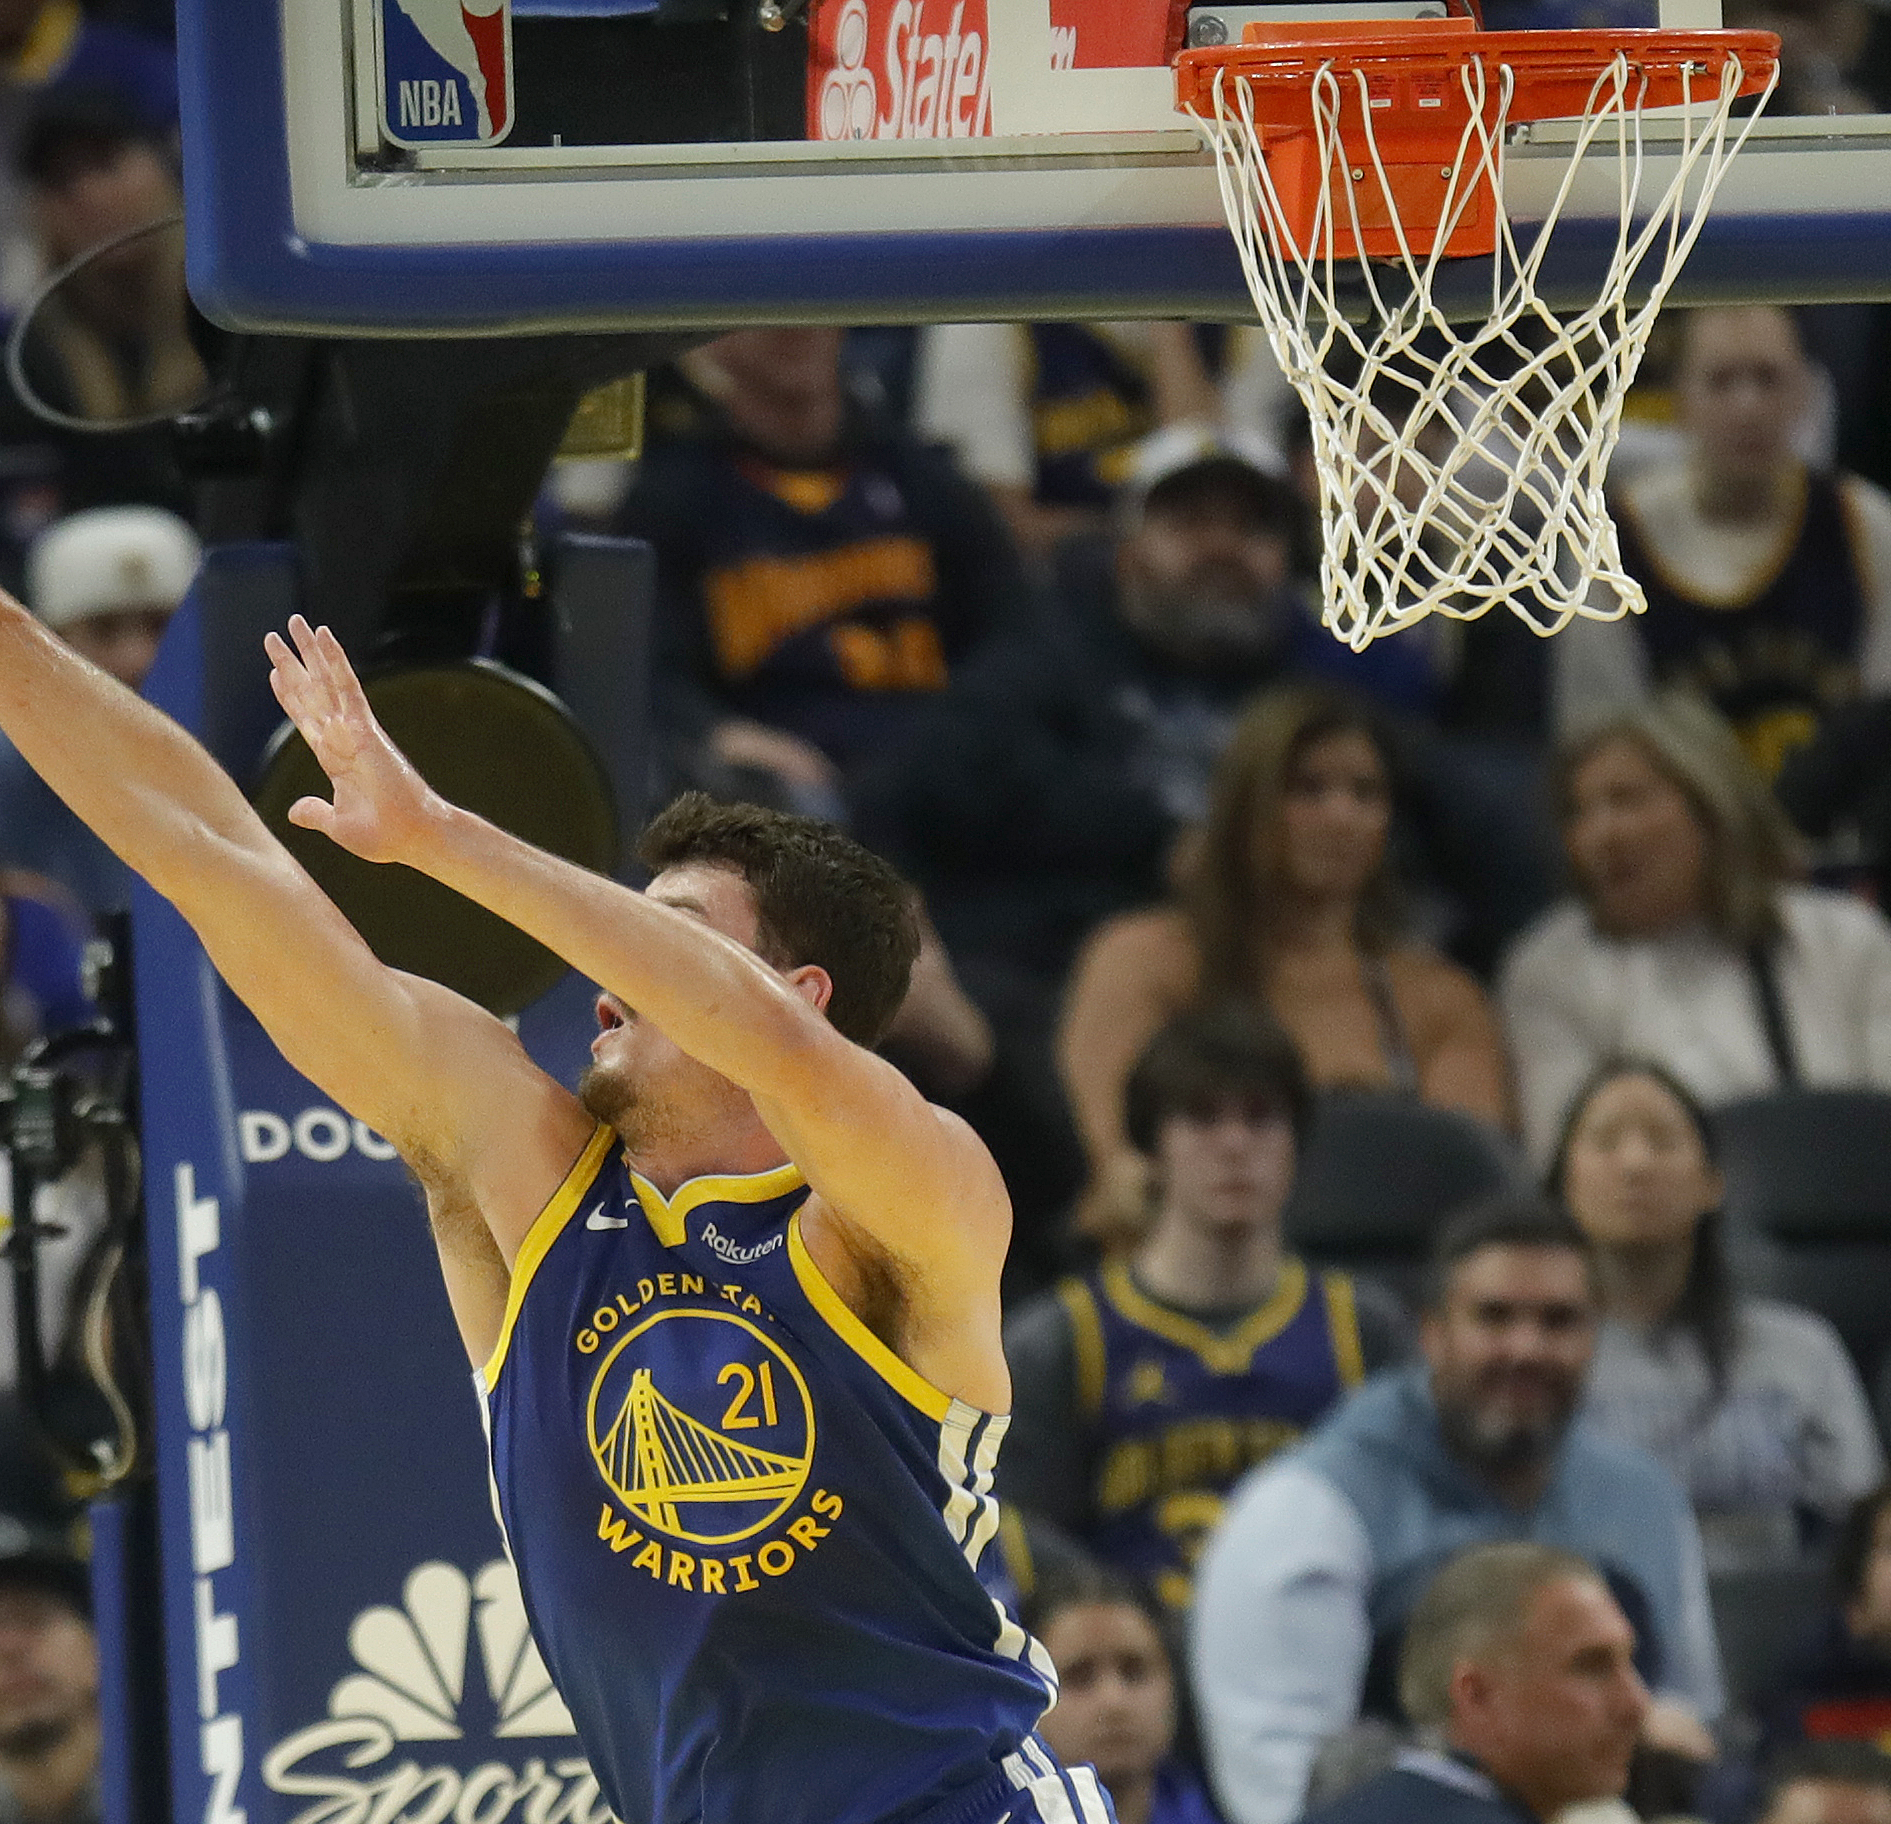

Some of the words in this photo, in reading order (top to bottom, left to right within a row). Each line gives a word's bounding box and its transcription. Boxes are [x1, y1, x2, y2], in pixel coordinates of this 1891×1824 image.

[399, 79, 463, 127] NBA
[701, 1222, 783, 1264] Rakuten
[576, 1273, 704, 1354] GOLDEN
[717, 1360, 778, 1430] 21
[598, 1488, 844, 1594] WARRIORS
